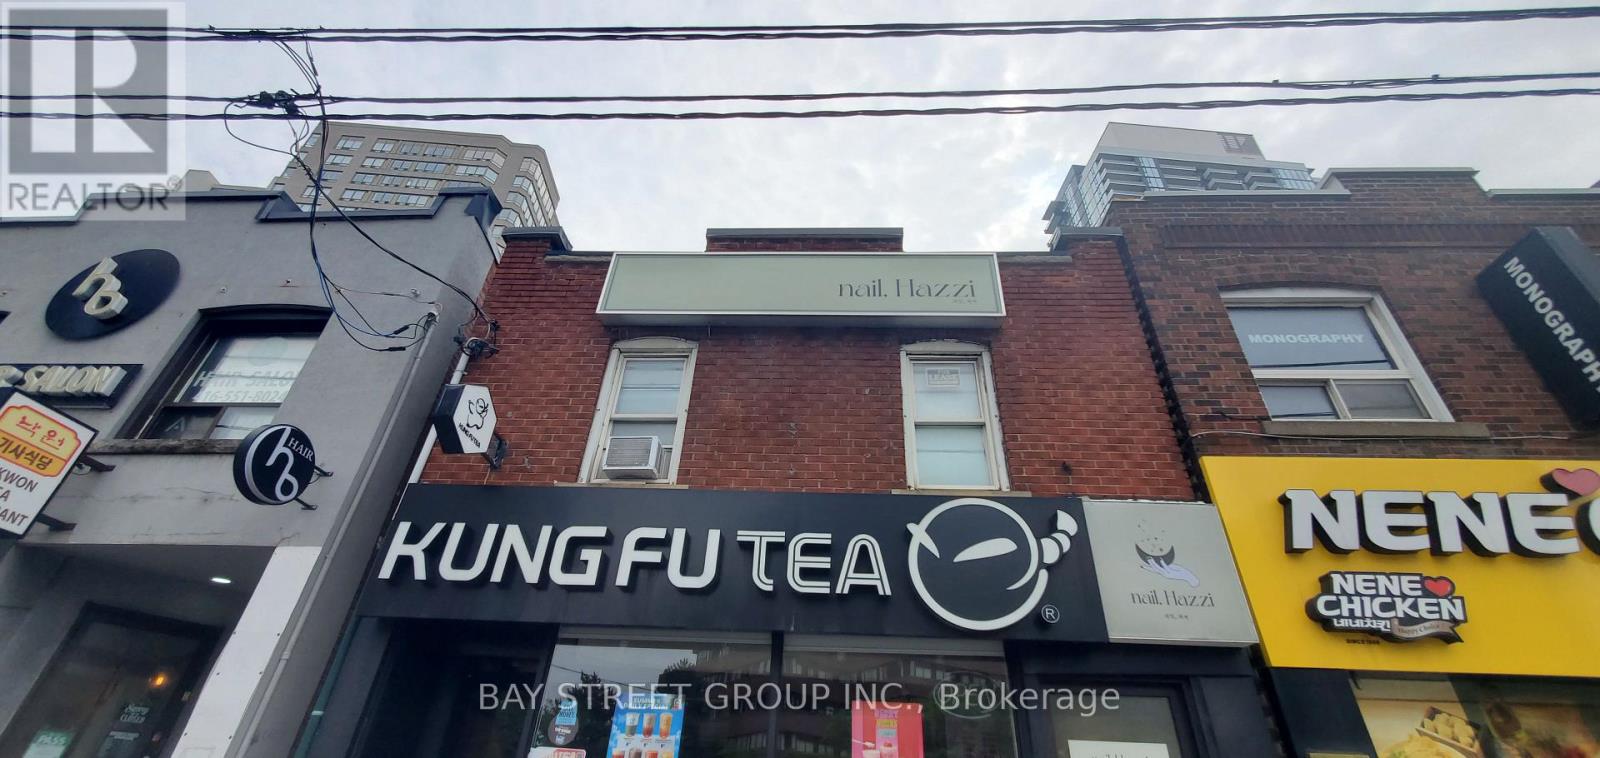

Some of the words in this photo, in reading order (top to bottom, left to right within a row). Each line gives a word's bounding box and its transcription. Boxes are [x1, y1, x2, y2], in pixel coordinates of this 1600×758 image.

[839, 279, 888, 298] nail.
[896, 279, 976, 298] Hazzi
[1504, 256, 1600, 392] MONOGRAPH
[1248, 334, 1365, 344] MONOGRAPHY
[22, 366, 128, 398] SALON
[0, 436, 54, 470] 기사식당
[287, 437, 314, 462] HAIR
[1284, 489, 1581, 553] NENE
[378, 521, 608, 585] KUNG
[615, 526, 721, 589] FU
[737, 530, 892, 596] TEA
[1330, 573, 1423, 596] NENE
[1131, 590, 1162, 606] nail.
[1164, 591, 1216, 608] Hazzi
[1317, 595, 1465, 620] CHICKEN
